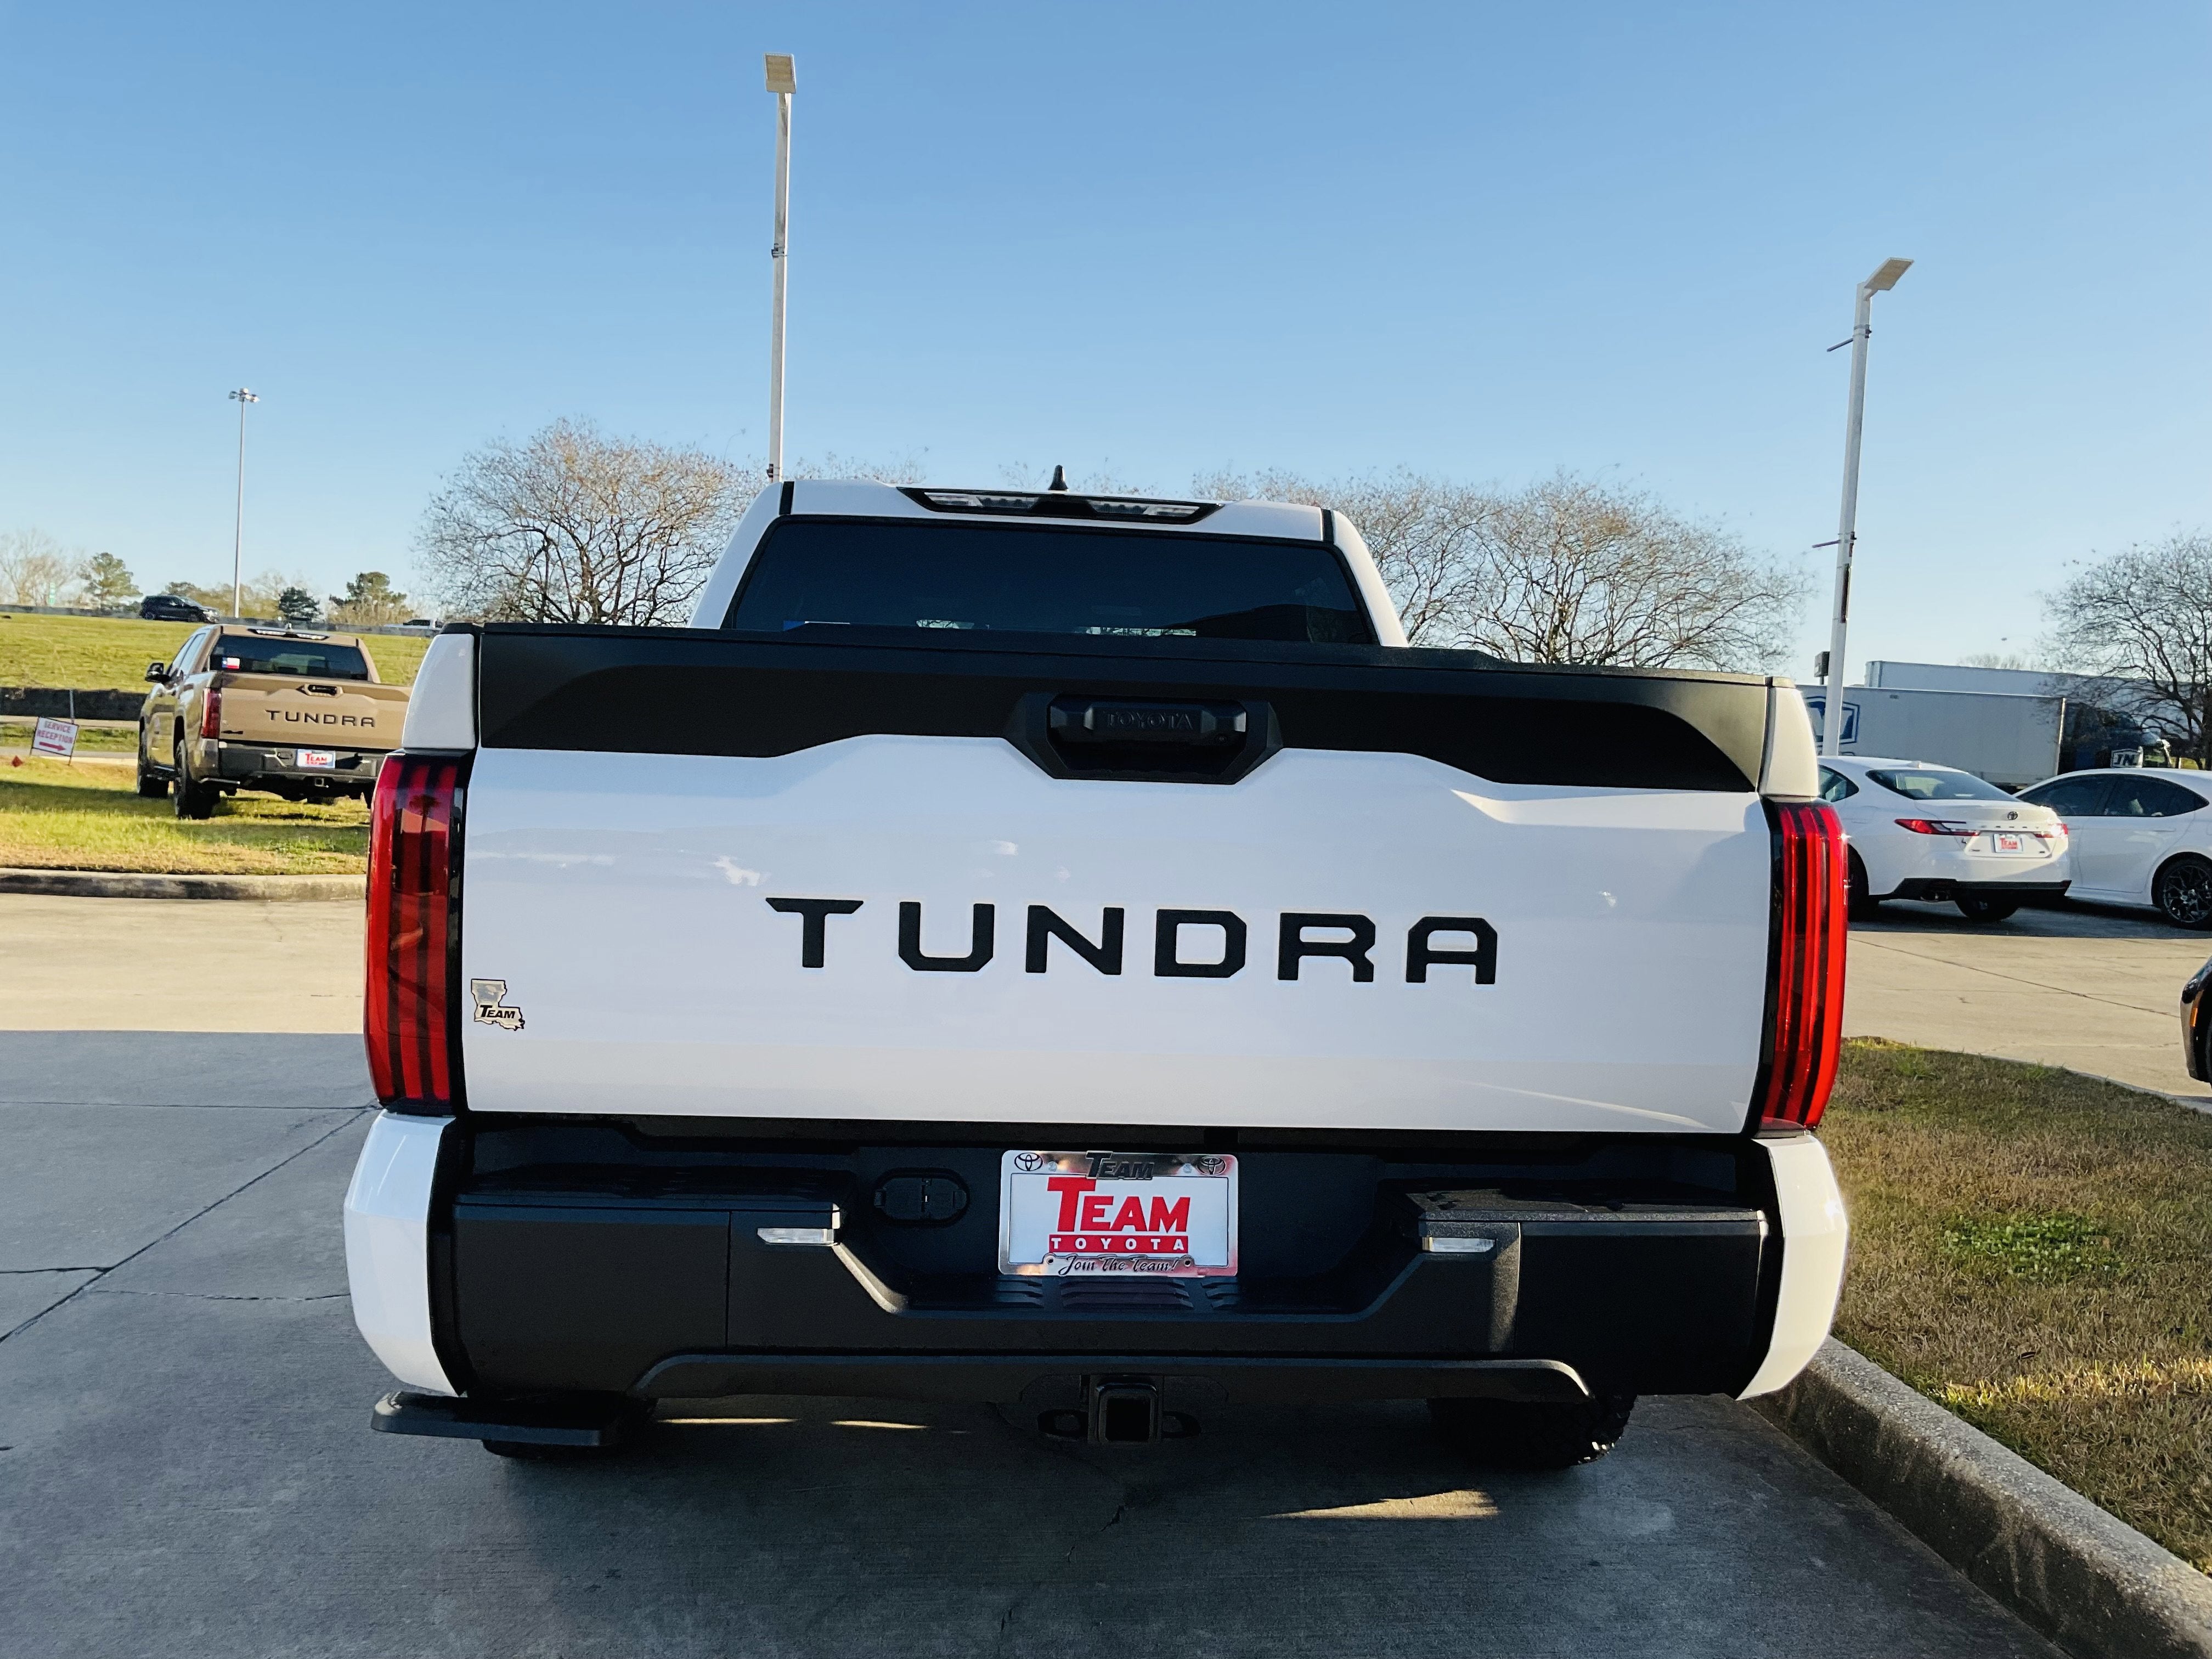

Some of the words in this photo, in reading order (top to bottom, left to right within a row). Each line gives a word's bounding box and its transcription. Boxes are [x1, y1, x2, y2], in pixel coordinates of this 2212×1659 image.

[44, 720, 71, 733] SERVICE
[265, 709, 375, 727] TUNDRA
[1103, 711, 1193, 730] TOYOTA
[37, 729, 74, 743] RECEPTION
[305, 753, 328, 761] TEAM
[765, 898, 1498, 985] TUNDRA
[480, 1005, 515, 1019] TEAM
[1085, 1151, 1154, 1180] TEAM
[1047, 1177, 1190, 1233] TEAM
[1051, 1237, 1185, 1251] TOYOTA
[1058, 1254, 1094, 1276] Join
[1098, 1255, 1125, 1272] The
[1128, 1256, 1180, 1272] Team!
